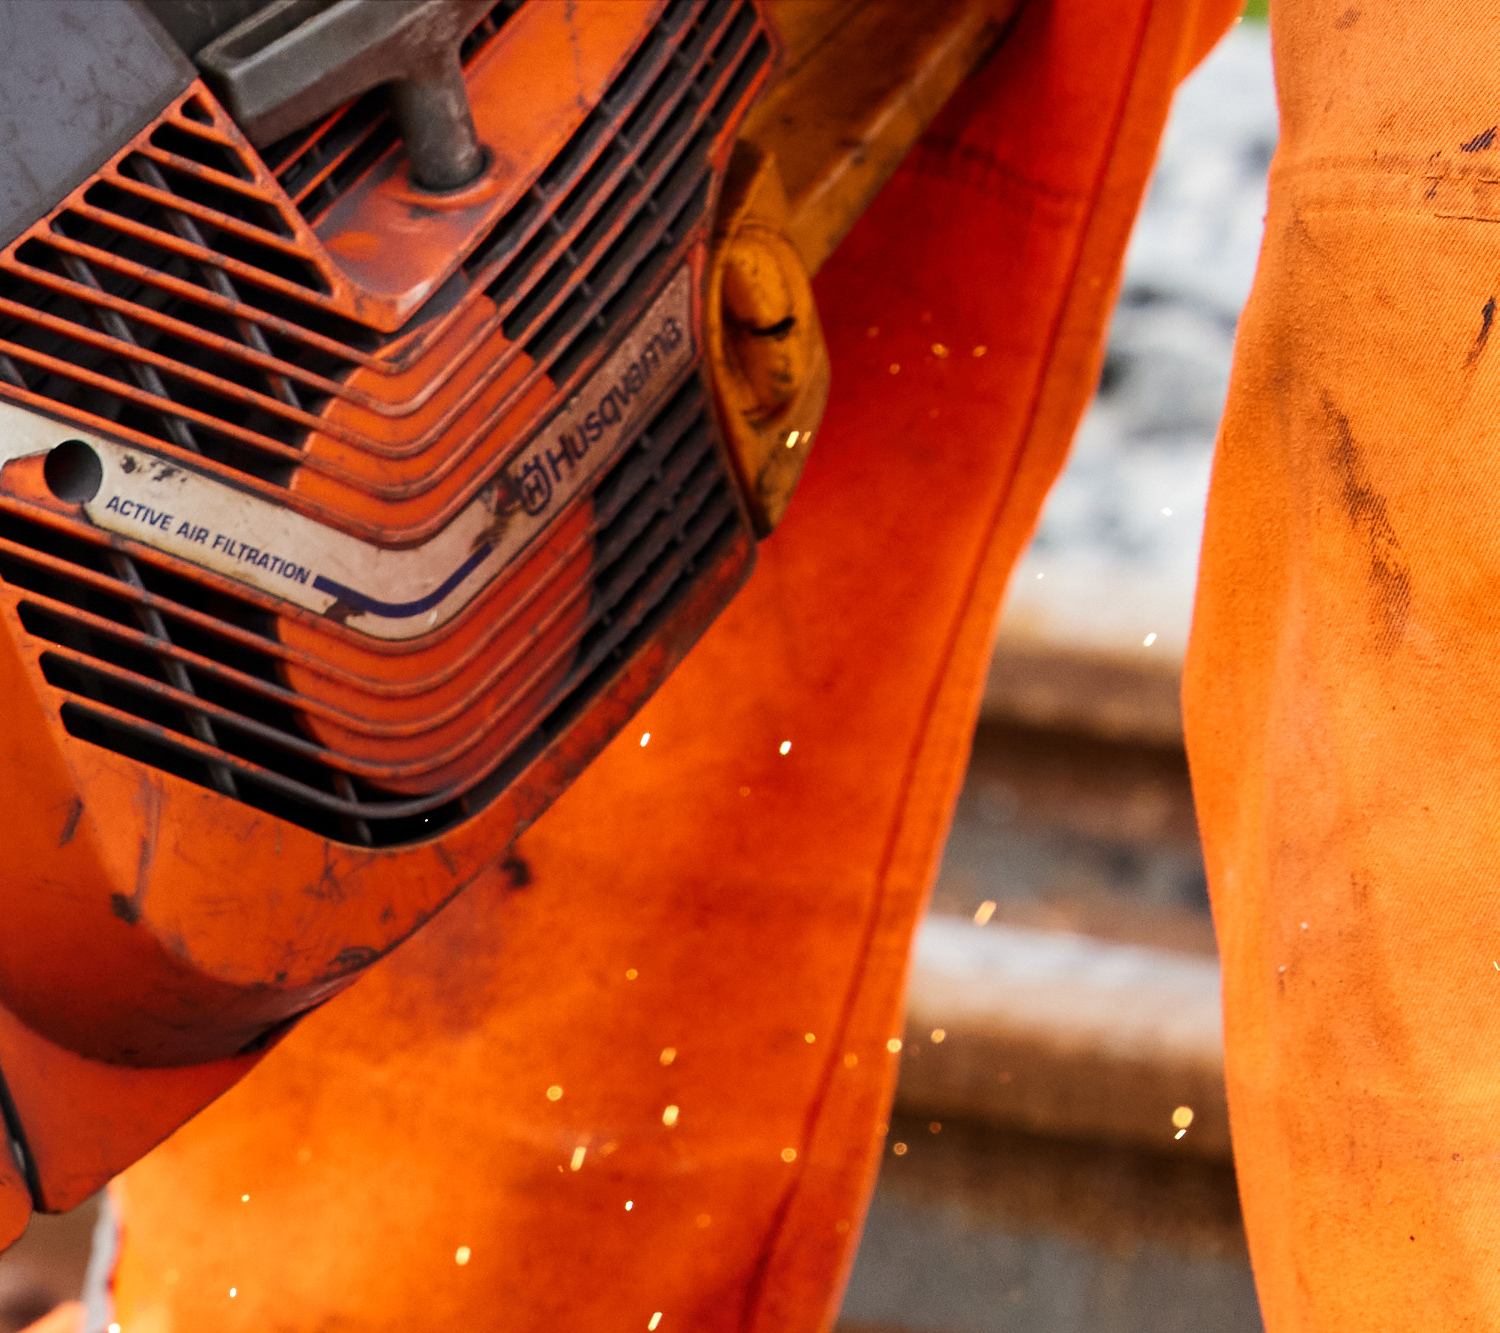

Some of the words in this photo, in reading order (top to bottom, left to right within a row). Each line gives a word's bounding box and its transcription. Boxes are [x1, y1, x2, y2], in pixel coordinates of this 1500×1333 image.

[105, 495, 174, 532] ACTIVE
[175, 521, 210, 545] AIR
[211, 533, 313, 585] FILTRATION
